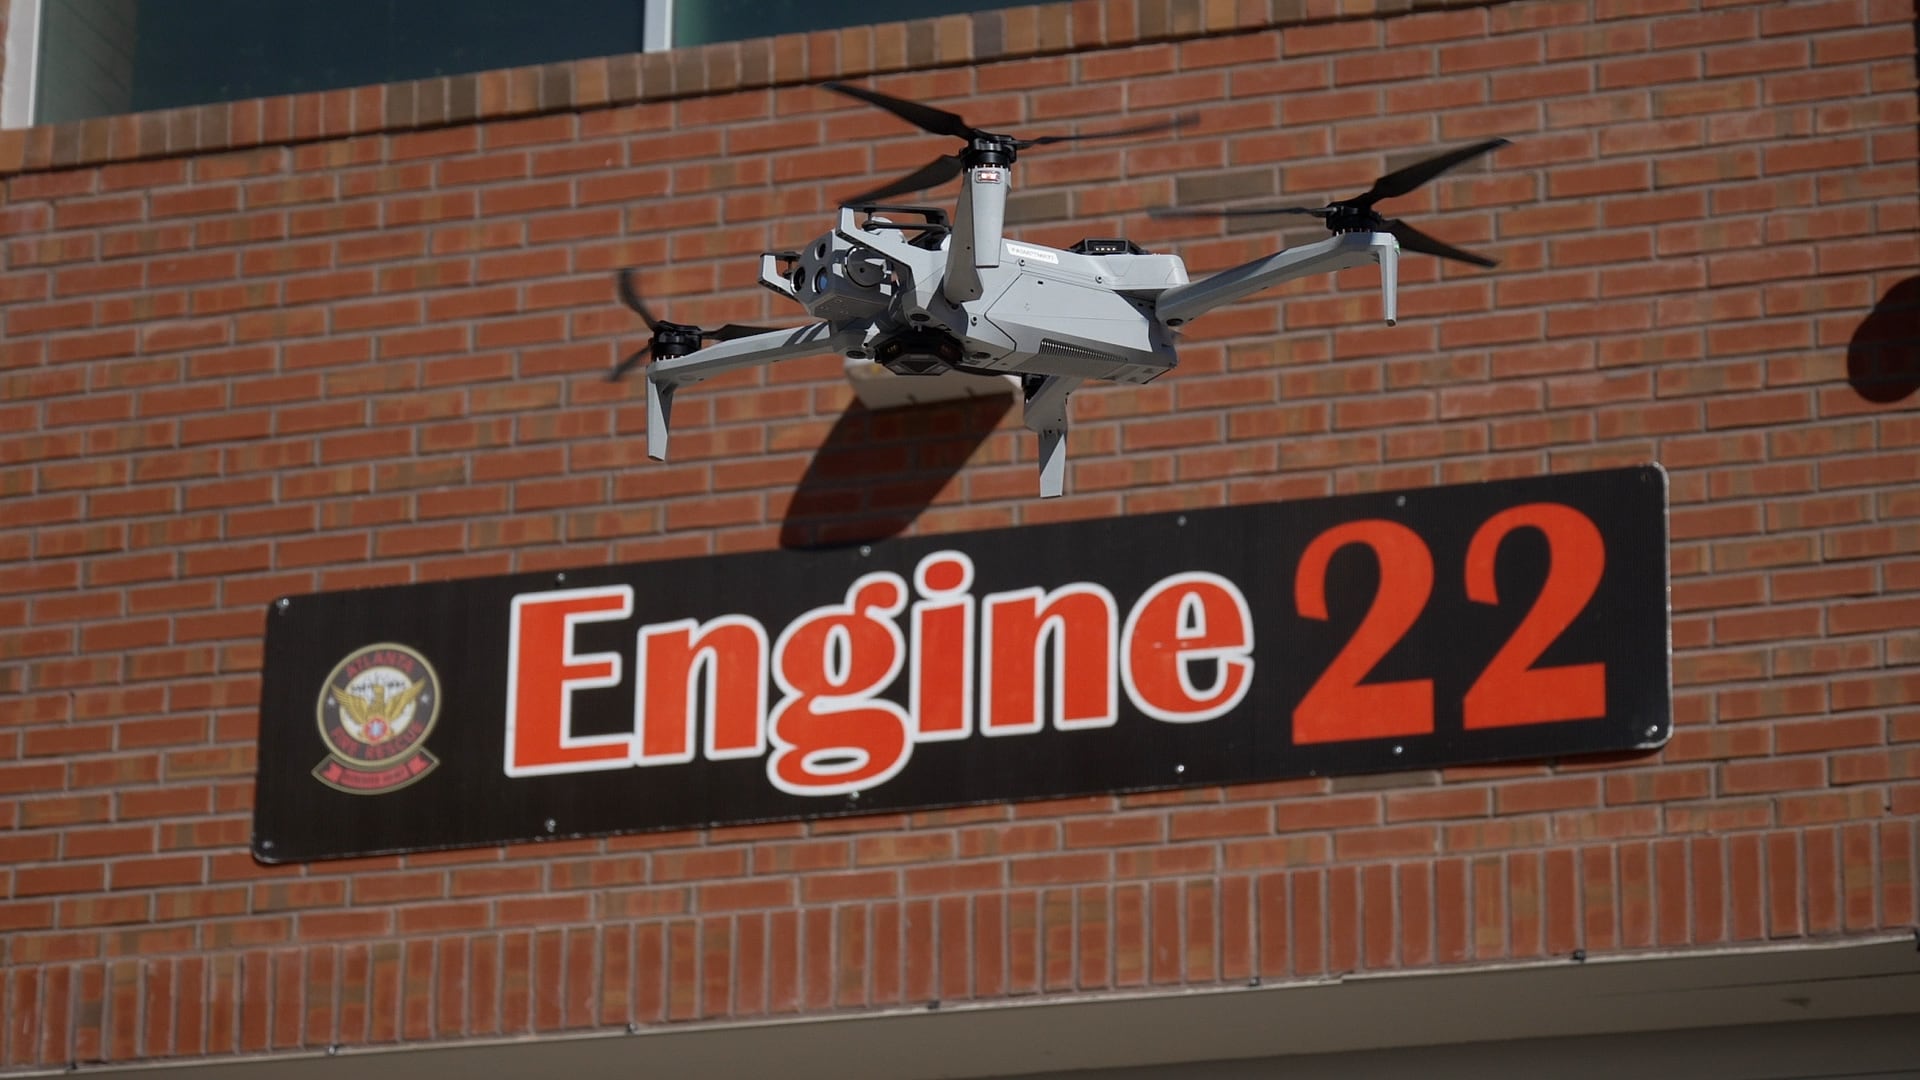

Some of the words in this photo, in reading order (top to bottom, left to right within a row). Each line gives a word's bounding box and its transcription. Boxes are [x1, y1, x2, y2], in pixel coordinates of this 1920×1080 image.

[345, 650, 415, 678] ATLANTA
[505, 551, 1254, 797] Engine
[1292, 503, 1606, 745] 22
